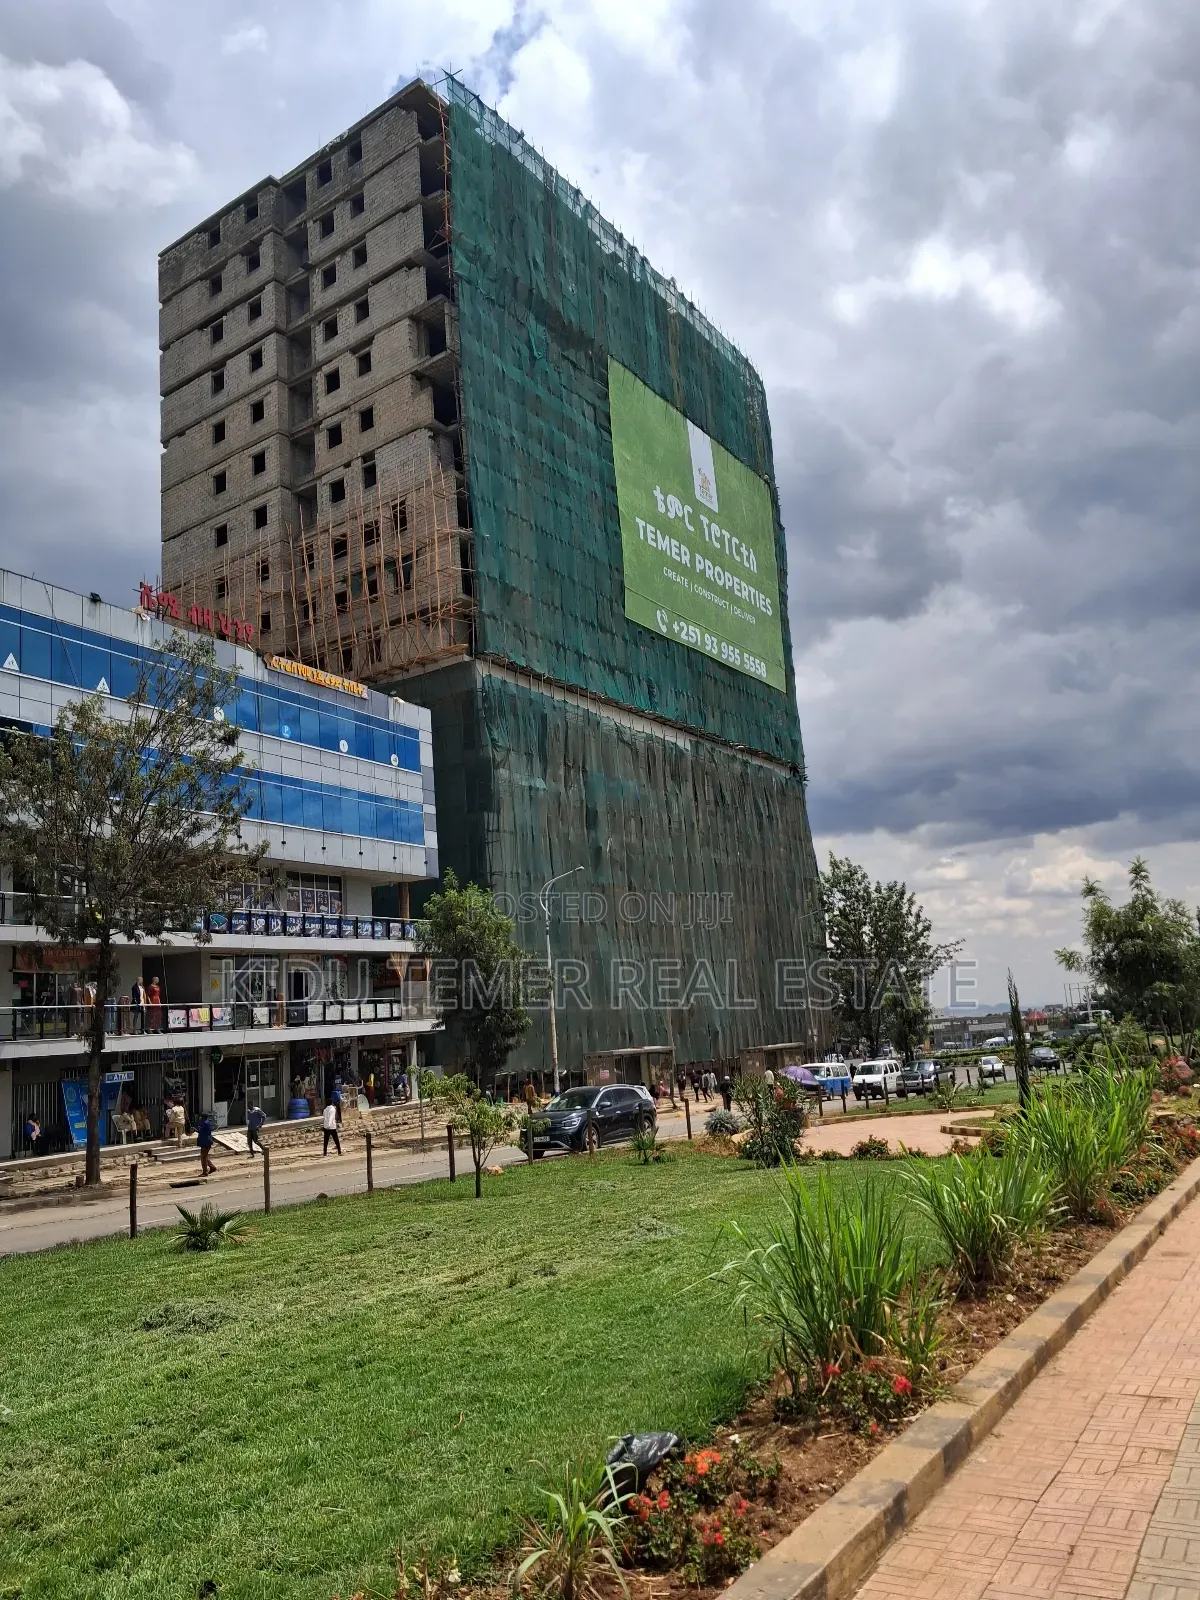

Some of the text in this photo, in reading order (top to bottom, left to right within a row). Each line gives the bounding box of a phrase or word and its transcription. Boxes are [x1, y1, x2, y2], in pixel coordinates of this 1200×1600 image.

[635, 516, 773, 617] TEMER PROPERTIES
[663, 566, 756, 625] CREATE CONSTRUCT DELIVER
[672, 621, 767, 678] +251 93 955 5558
[55, 949, 86, 957] FASHION
[113, 1073, 127, 1081] ATM
